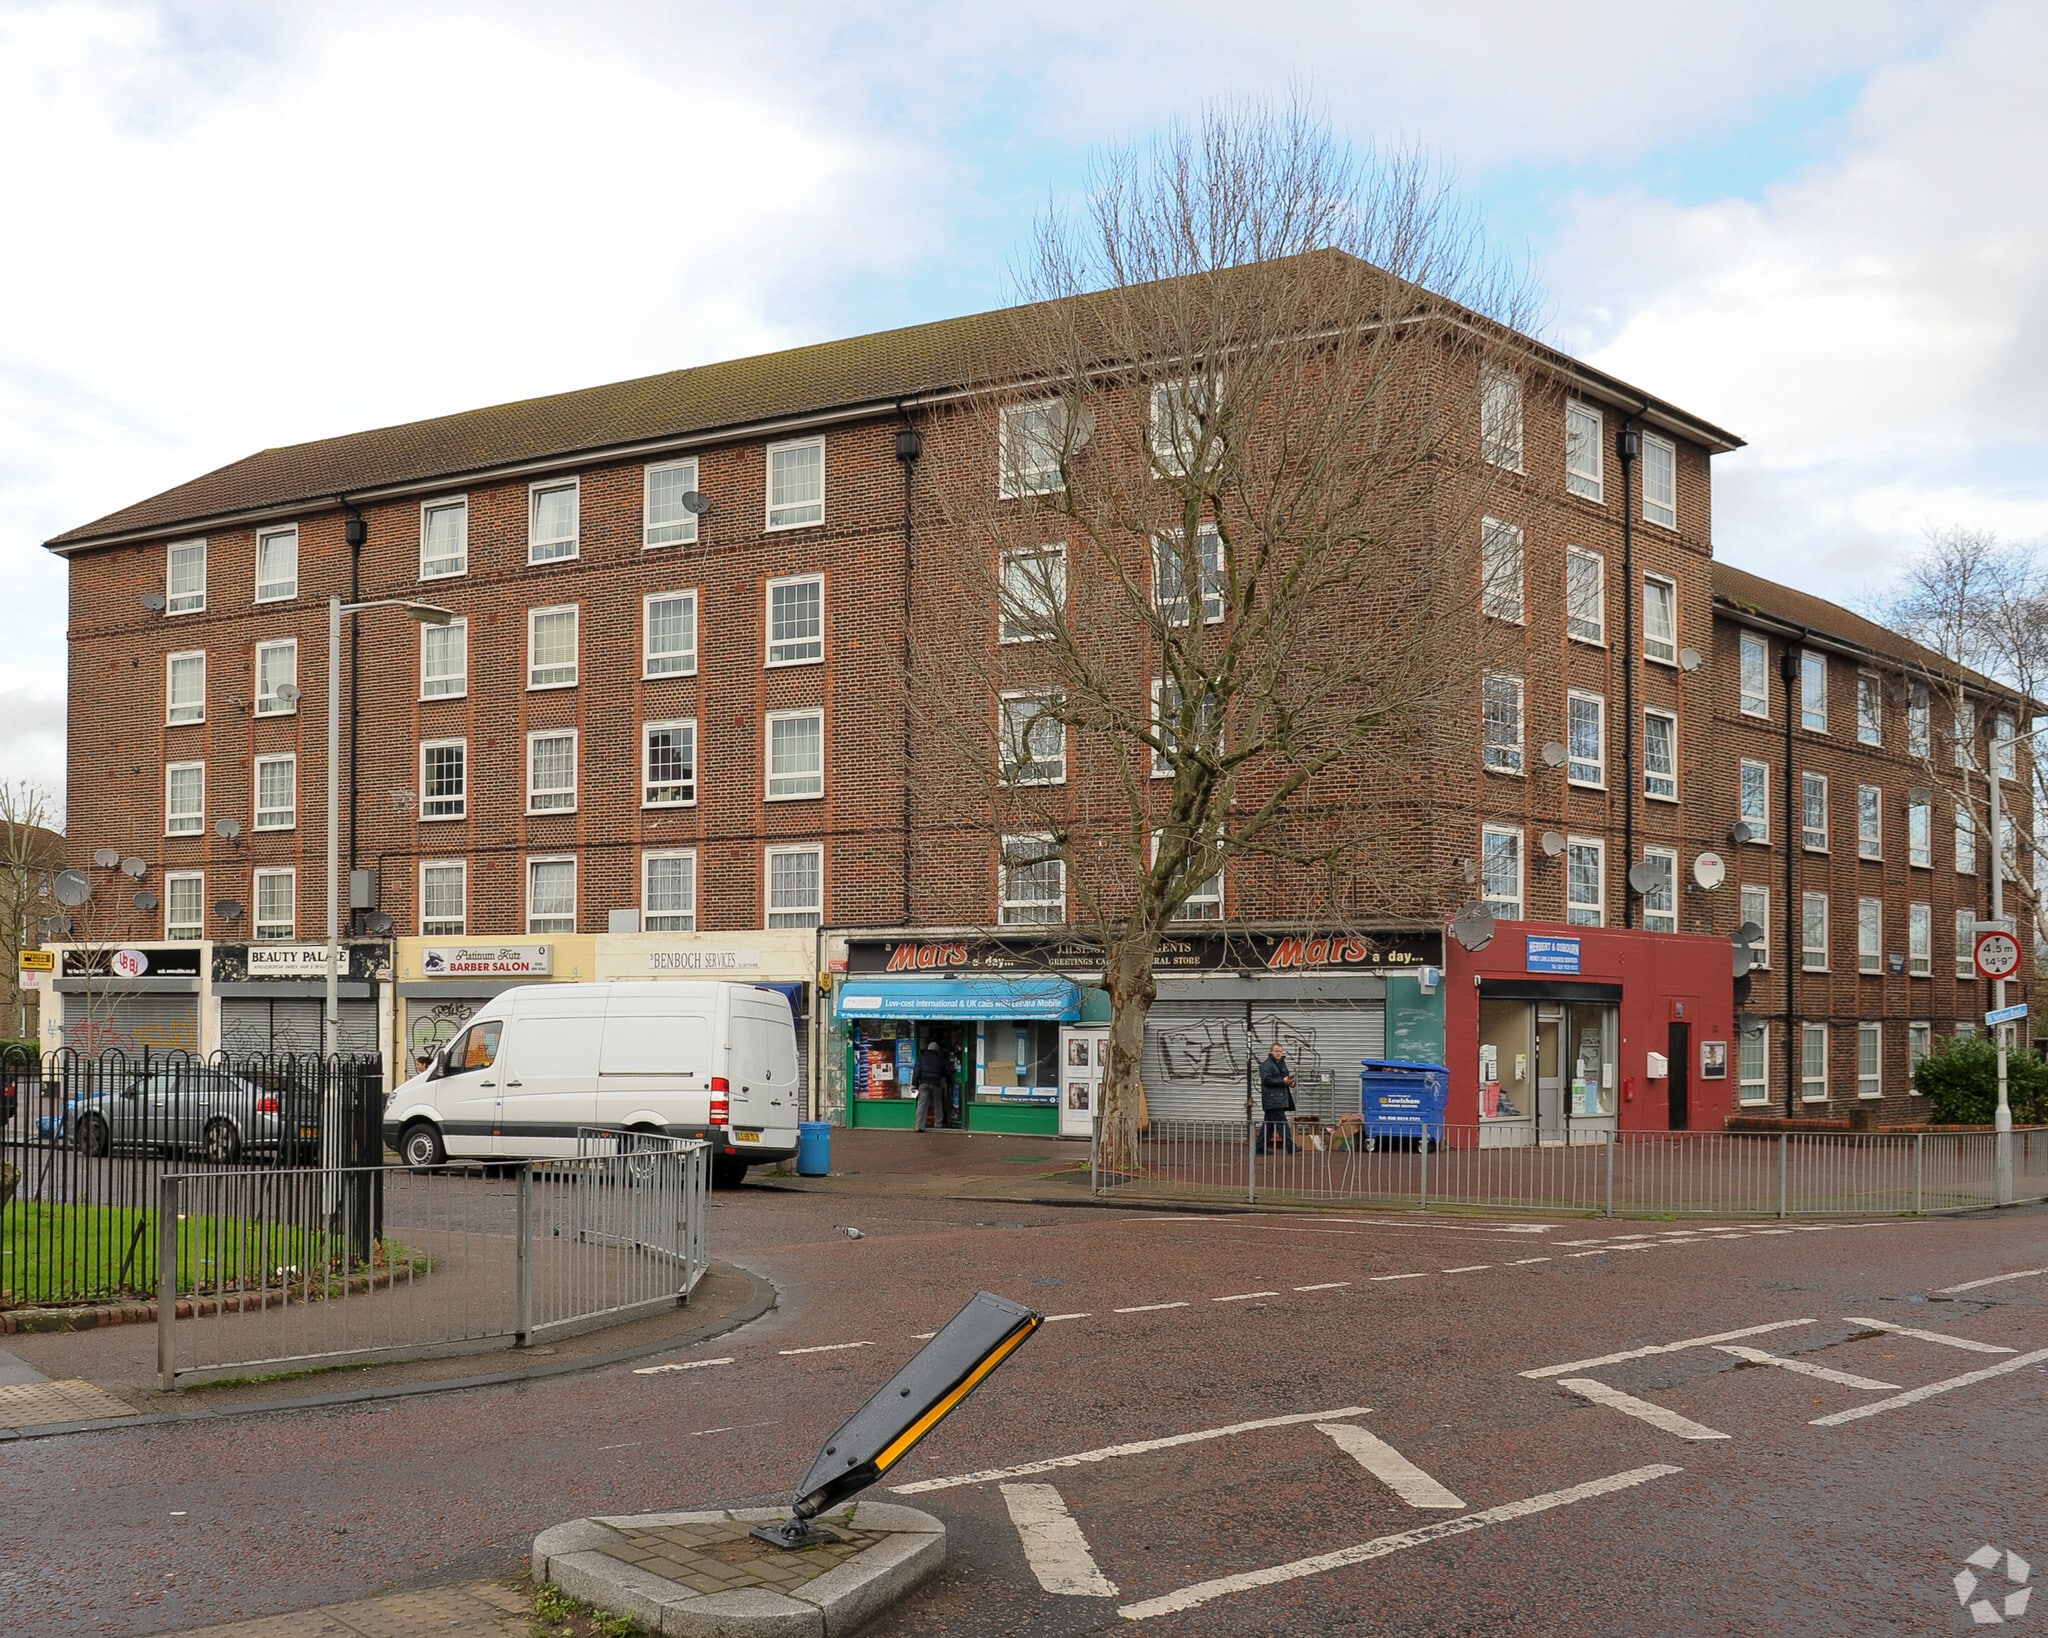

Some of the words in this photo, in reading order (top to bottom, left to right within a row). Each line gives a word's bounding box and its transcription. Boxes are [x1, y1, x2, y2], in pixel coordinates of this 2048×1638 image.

[1268, 937, 1367, 969] Mars
[1983, 944, 2002, 953] 4.5
[252, 951, 298, 963] BEAUTY
[303, 951, 347, 962] PALE
[455, 949, 496, 961] Platinum
[654, 952, 701, 968] BENBOCH
[705, 952, 736, 968] SERVICES
[886, 942, 968, 972] Mars
[1372, 952, 1380, 962] a
[1048, 957, 1094, 966] GREETINGS
[1173, 956, 1201, 965] STORE
[450, 962, 490, 972] BARBER
[492, 962, 530, 972] SALON
[885, 999, 915, 1008] Low-cost
[966, 999, 978, 1008] UK
